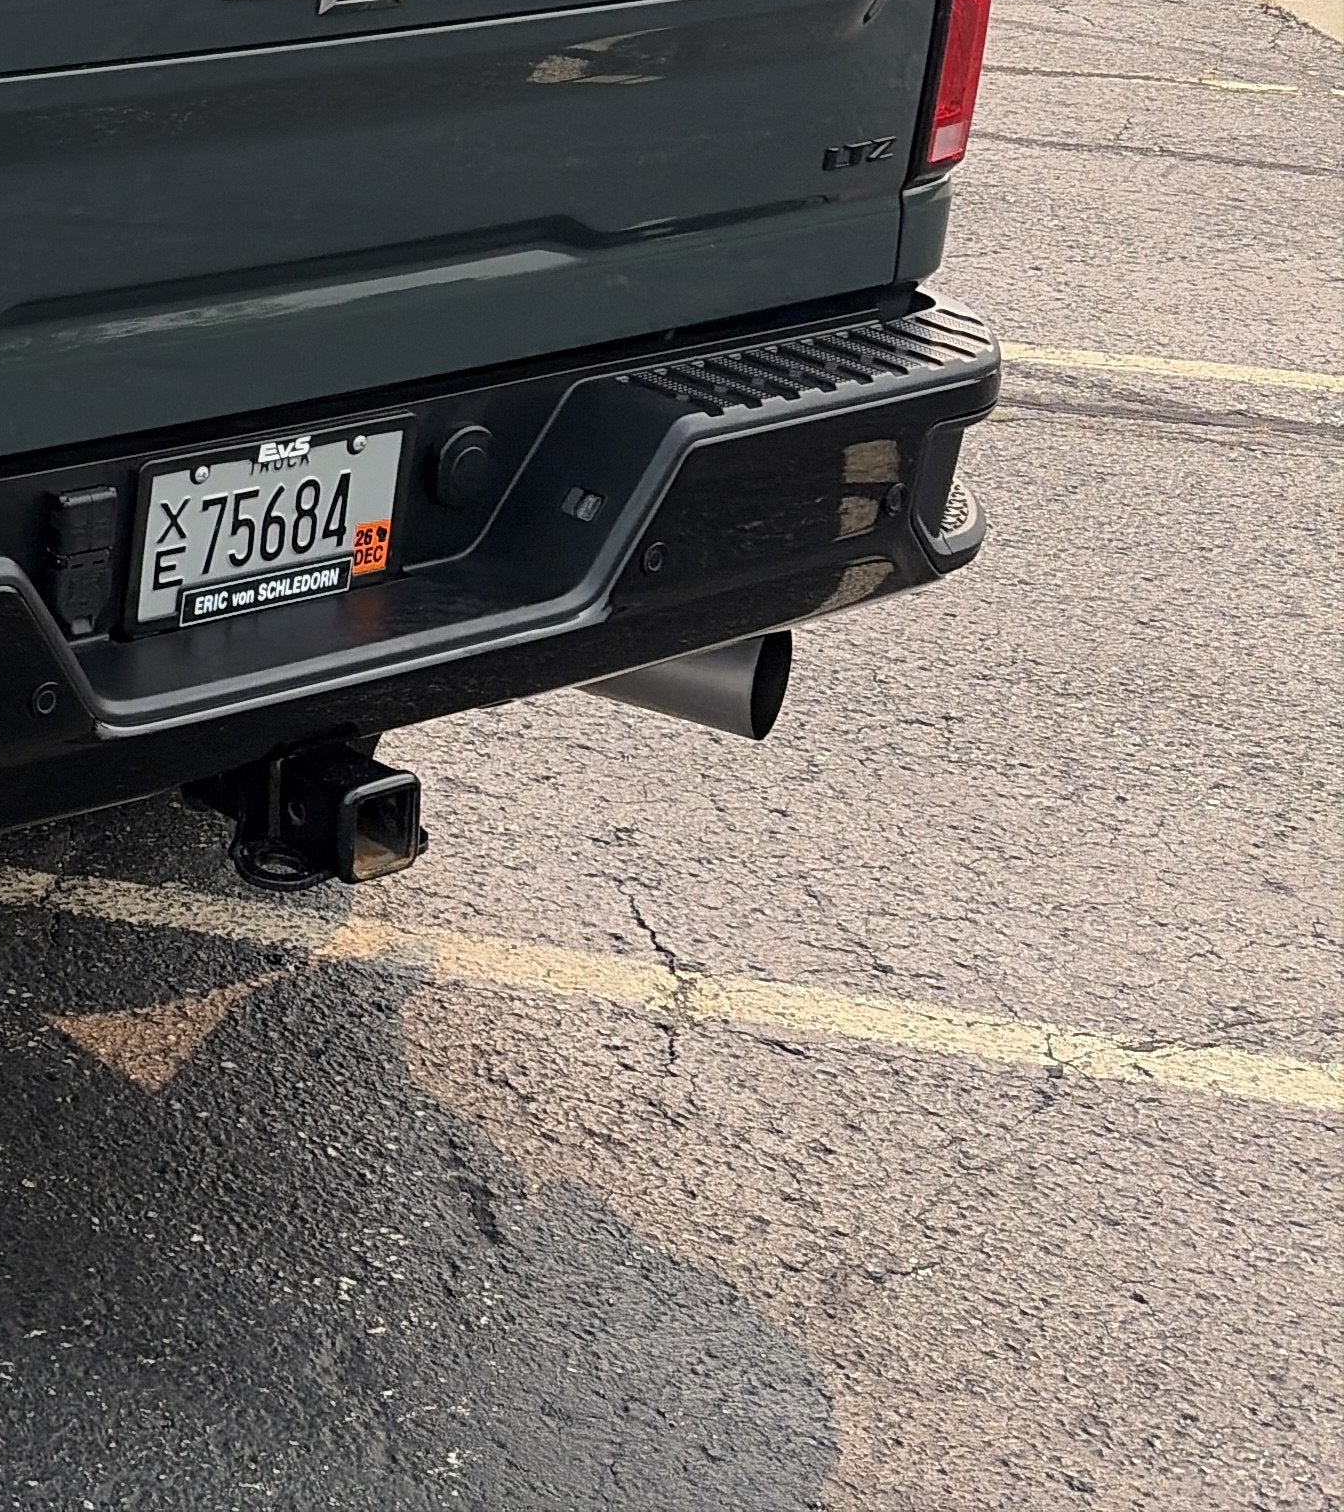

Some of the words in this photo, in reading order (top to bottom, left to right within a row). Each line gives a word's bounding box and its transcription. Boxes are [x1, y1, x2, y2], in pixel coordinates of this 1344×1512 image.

[822, 136, 896, 171] LTZ
[201, 469, 352, 575] 75684
[355, 529, 373, 545] 26
[353, 546, 384, 567] DEC
[194, 592, 228, 615] ERIC
[232, 589, 255, 607] von
[257, 567, 340, 602] SCHLEDORN
